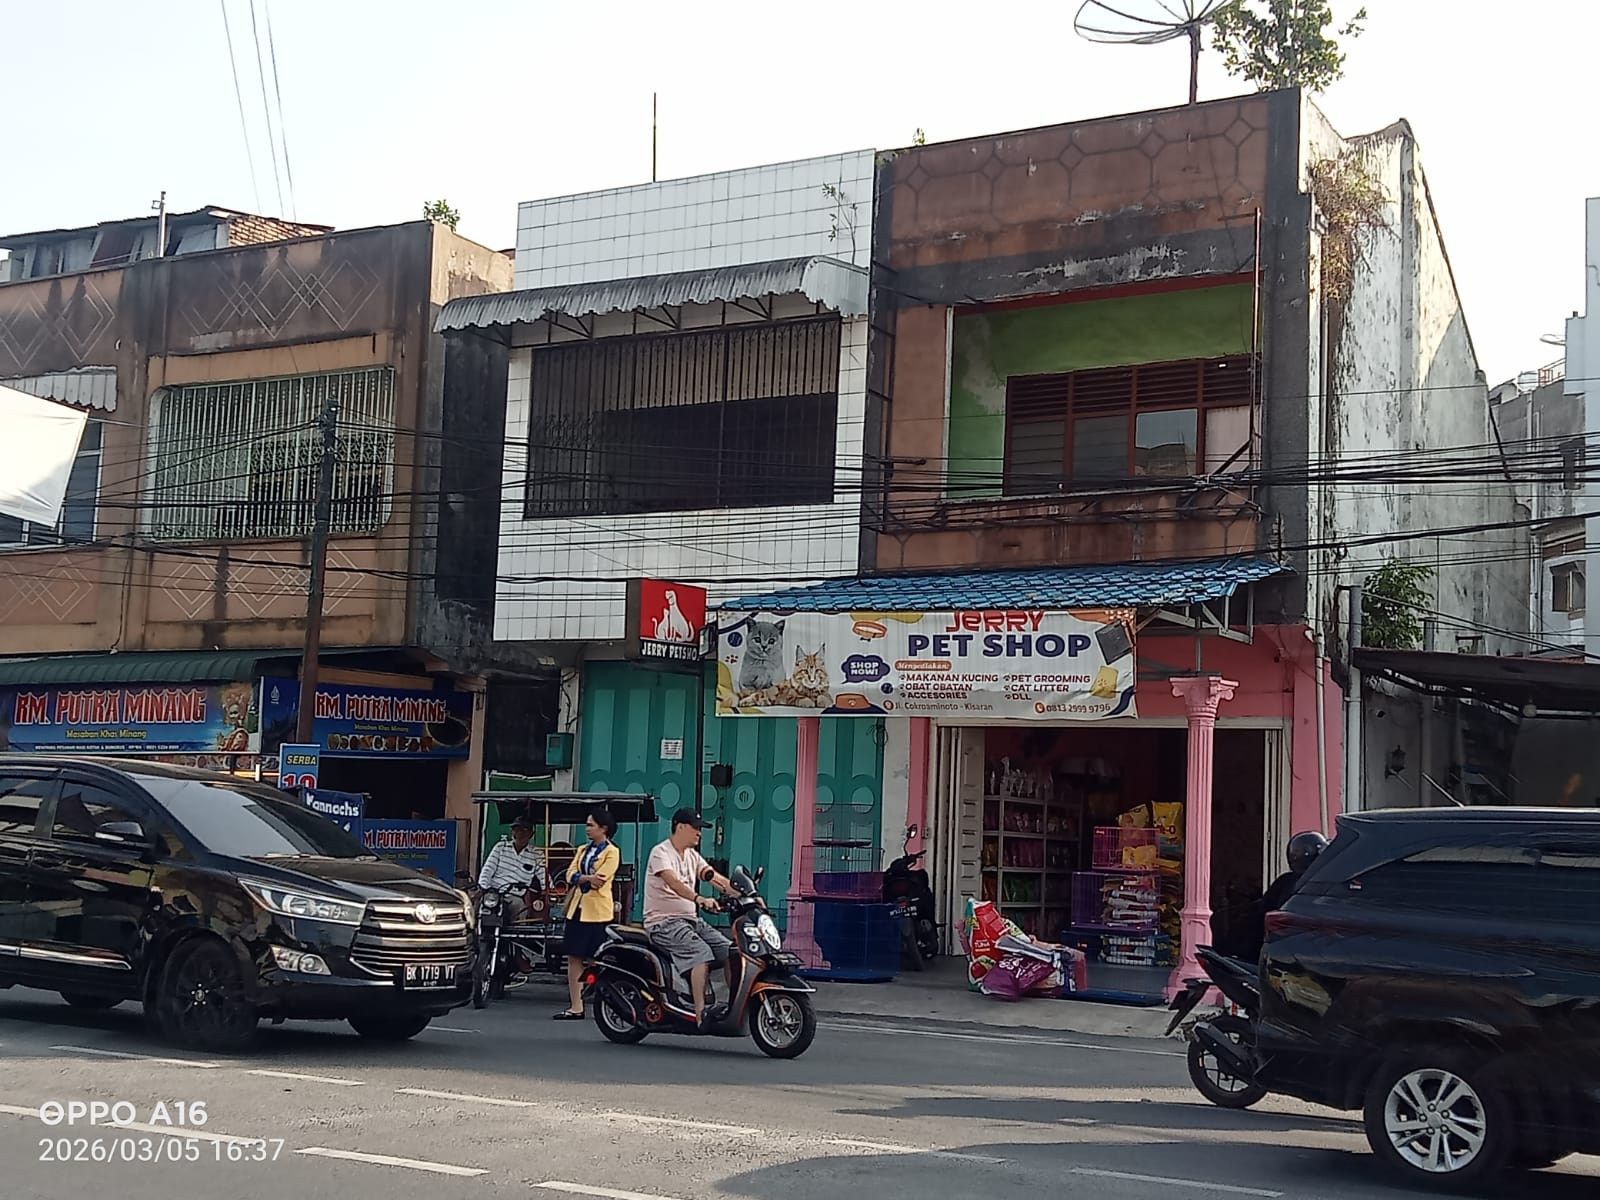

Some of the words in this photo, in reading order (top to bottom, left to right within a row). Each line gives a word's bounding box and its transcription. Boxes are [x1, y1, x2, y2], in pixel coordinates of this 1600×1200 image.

[641, 641, 668, 658] JERRY
[669, 644, 700, 661] PETSHO
[908, 634, 973, 657] PET
[983, 634, 1091, 658] SHOP
[850, 661, 879, 669] SHOP
[962, 674, 999, 682] KUCING
[1034, 675, 1091, 683] GROOMING
[933, 683, 973, 691] OBATAN
[1011, 684, 1032, 692] CAT
[14, 691, 51, 725] RM.
[55, 690, 120, 725] PUTRA
[123, 688, 208, 725] MINANG
[314, 691, 343, 720] RM.
[345, 694, 392, 721] PUTRA
[393, 697, 447, 724] MINANG
[1046, 704, 1067, 712] 0813
[119, 729, 147, 739] Minang
[286, 755, 317, 765] SERBA
[375, 829, 409, 849] PUTRA
[409, 829, 447, 849] MINANG
[406, 966, 417, 980] BK
[421, 966, 440, 980] 1719
[445, 965, 455, 979] VT
